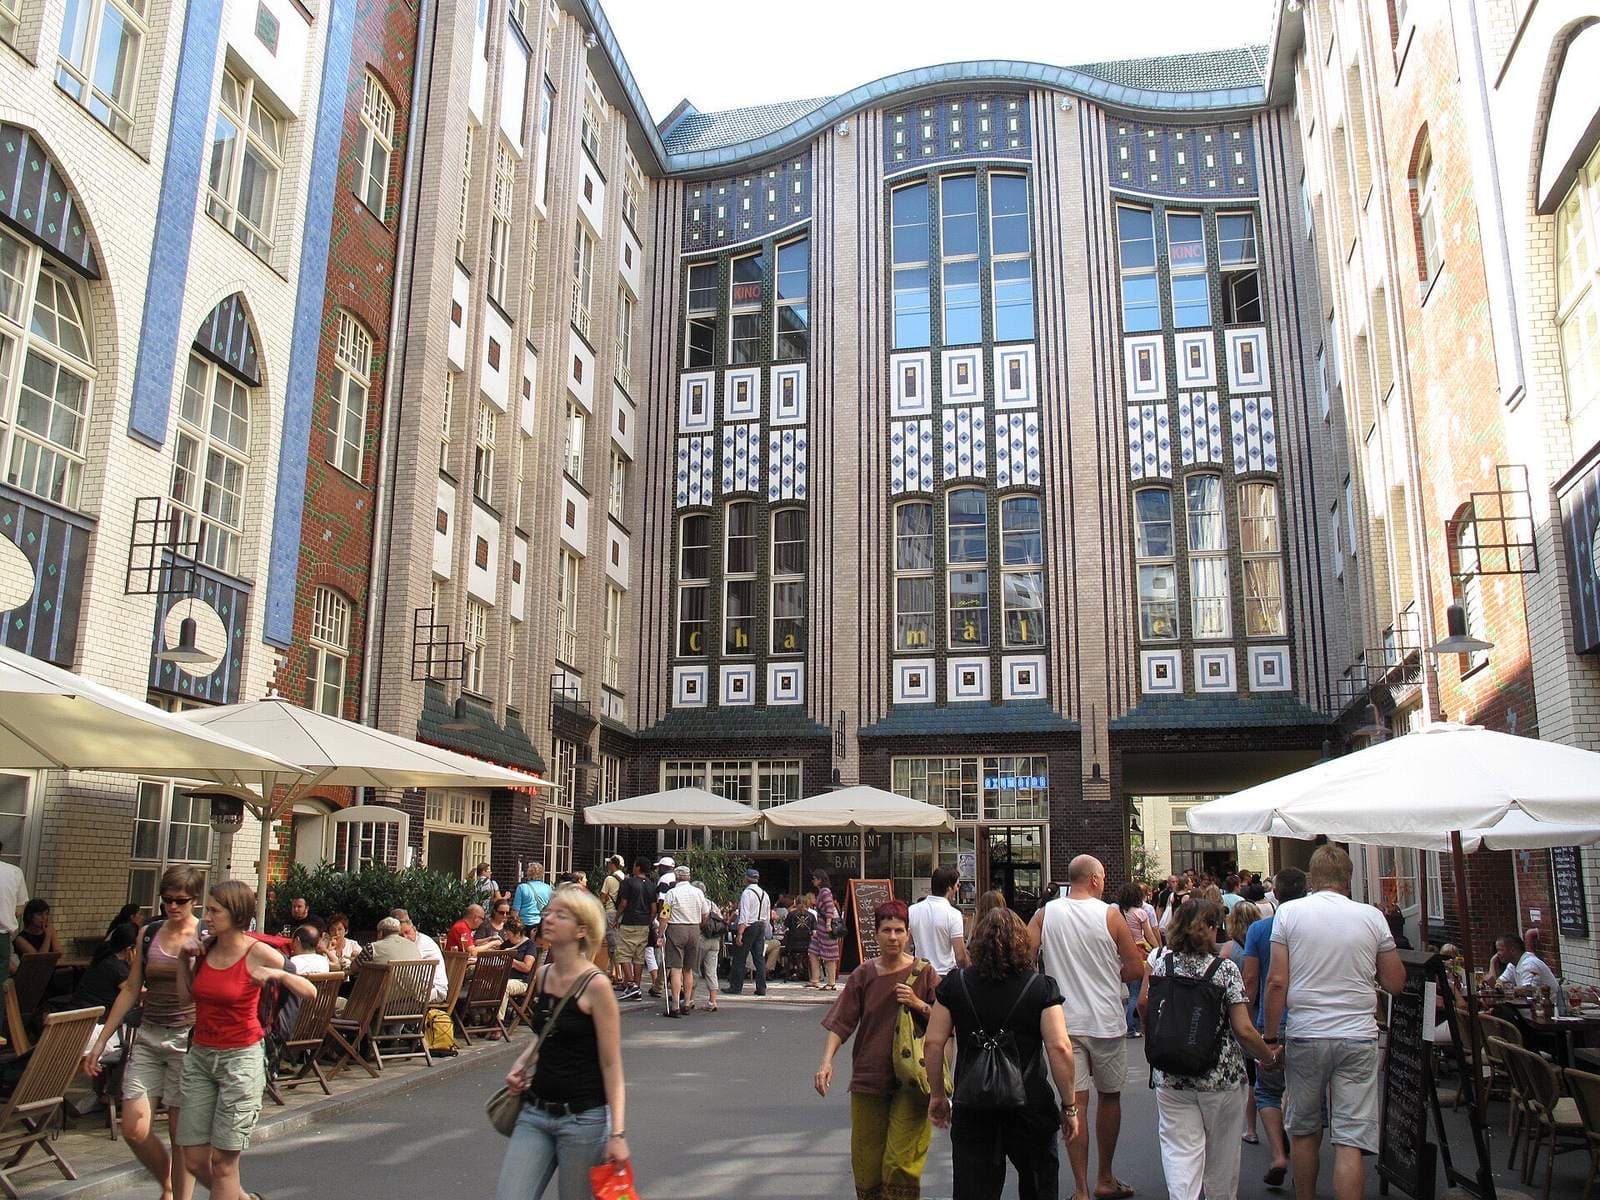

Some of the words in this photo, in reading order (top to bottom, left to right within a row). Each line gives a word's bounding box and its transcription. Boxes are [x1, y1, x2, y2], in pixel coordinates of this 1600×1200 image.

[1172, 245, 1202, 259] KINO
[735, 286, 760, 299] KINO
[834, 855, 857, 869] BAR
